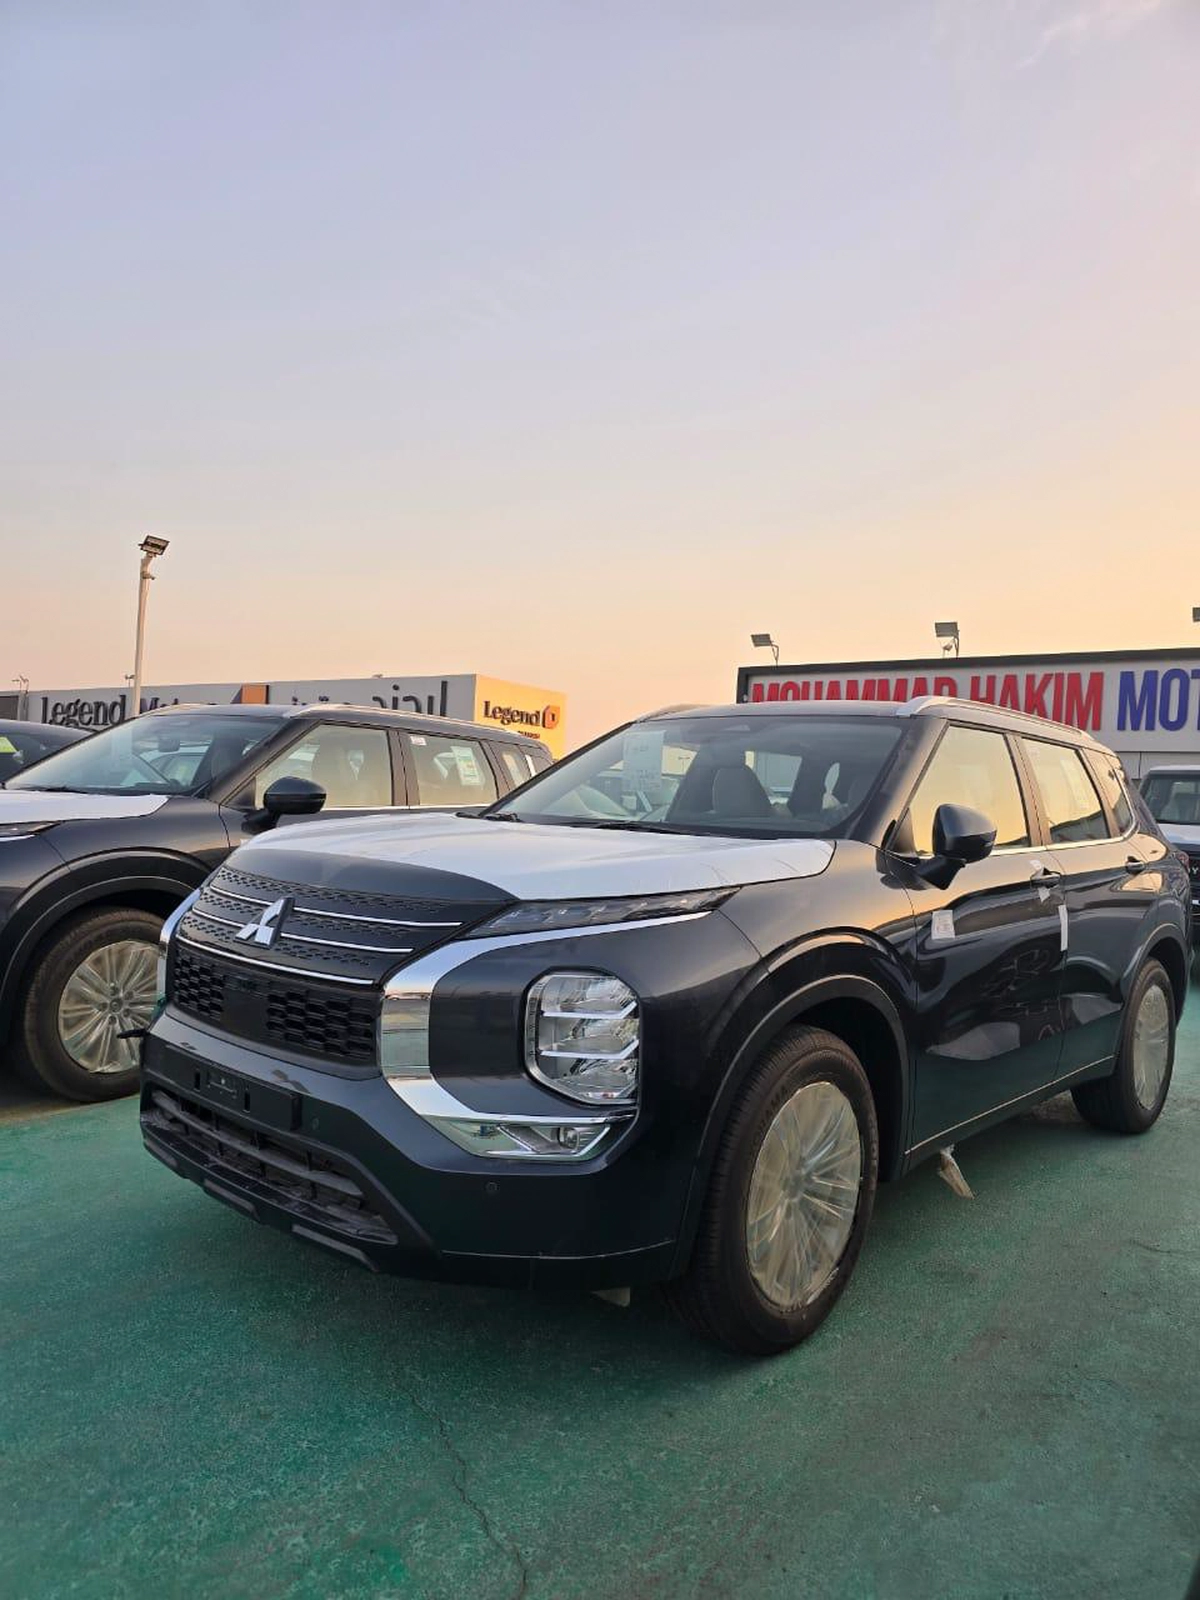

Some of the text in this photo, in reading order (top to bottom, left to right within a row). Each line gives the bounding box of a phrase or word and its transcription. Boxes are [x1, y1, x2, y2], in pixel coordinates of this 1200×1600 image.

[41, 695, 127, 728] Legend
[483, 700, 541, 727] Legend
[970, 671, 1104, 732] HAKIM
